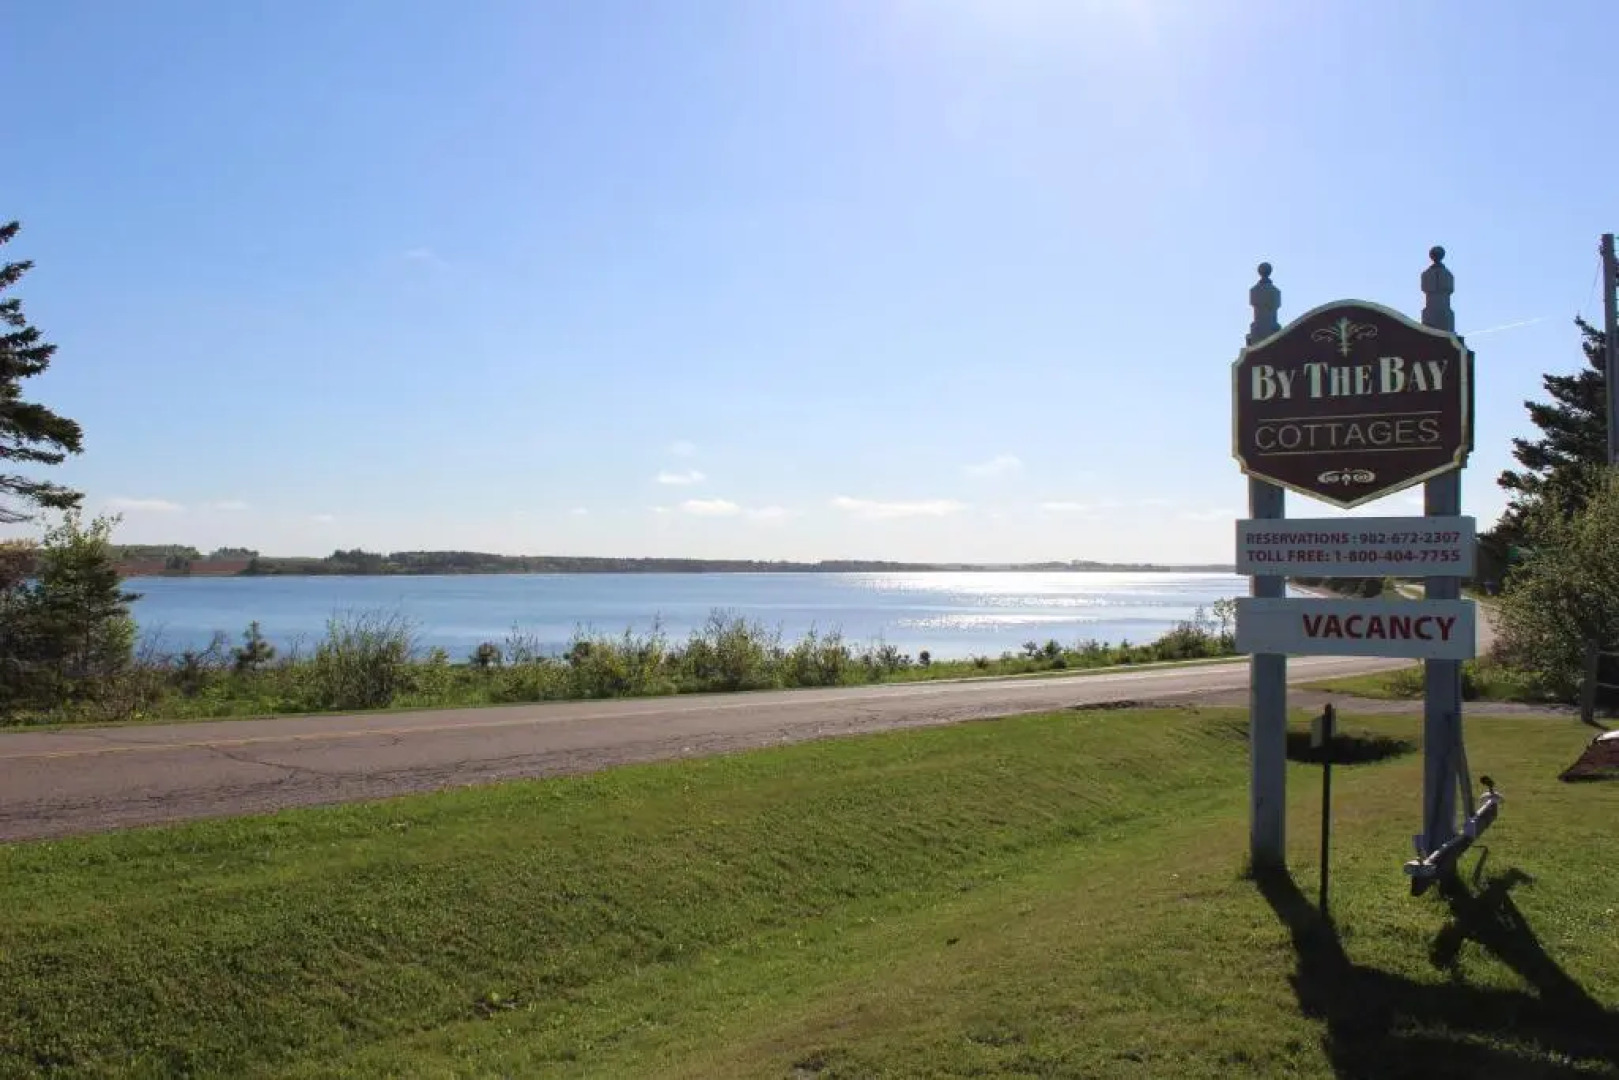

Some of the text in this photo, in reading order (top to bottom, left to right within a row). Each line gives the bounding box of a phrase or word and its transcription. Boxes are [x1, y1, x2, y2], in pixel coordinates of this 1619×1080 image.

[1251, 356, 1449, 400] BY THE BAY
[1254, 418, 1441, 450] COTTAGES
[1246, 549, 1461, 563] TOLL FREE: 1-800-404-7755
[1302, 613, 1457, 642] VACANCY
